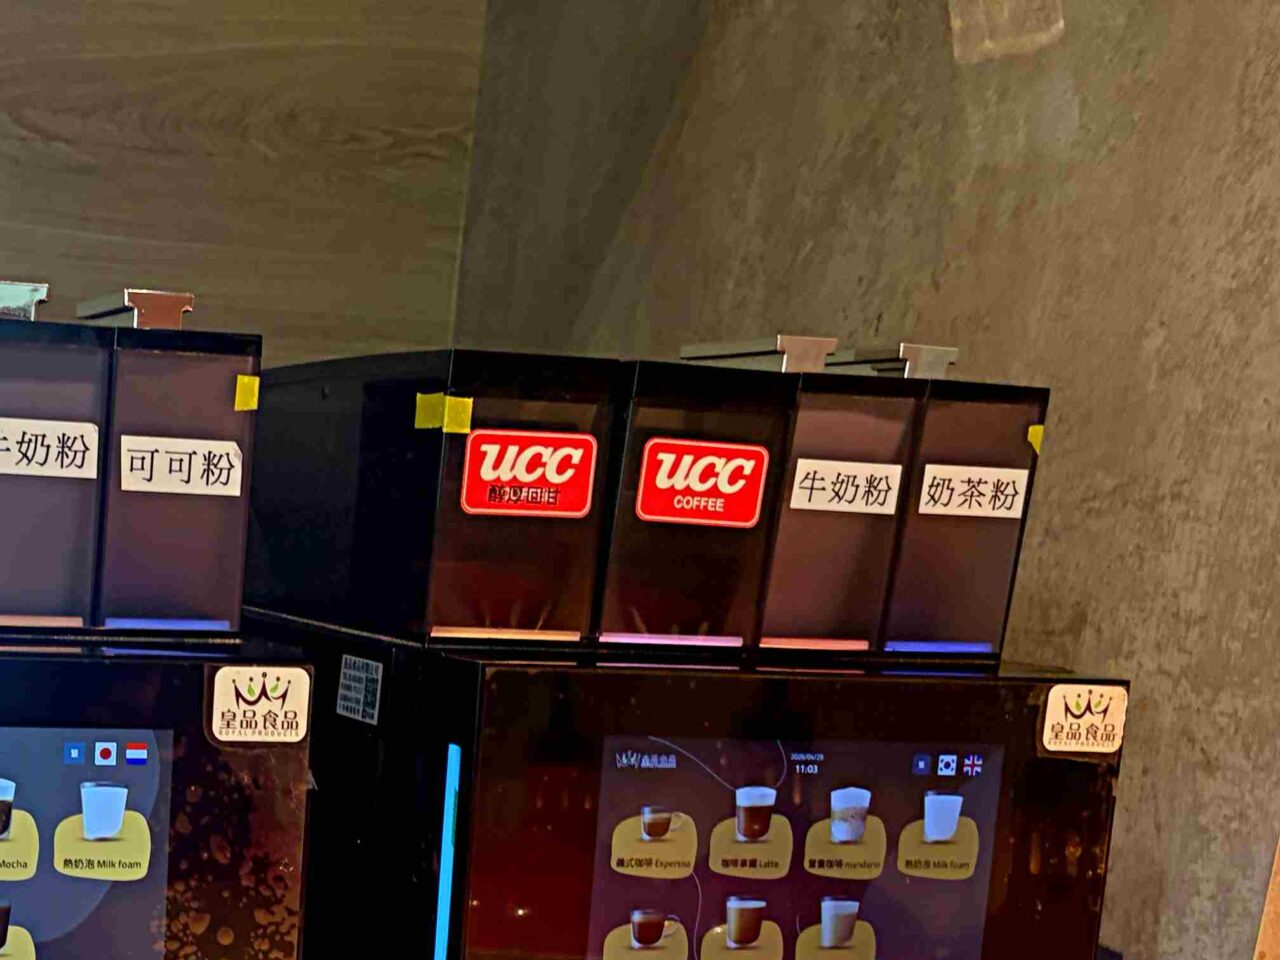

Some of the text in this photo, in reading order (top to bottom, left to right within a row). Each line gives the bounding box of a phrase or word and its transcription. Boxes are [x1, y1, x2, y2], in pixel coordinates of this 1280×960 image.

[126, 447, 235, 487] 可可粉
[479, 443, 584, 484] UCC
[655, 452, 756, 494] UCC
[673, 494, 725, 512] COFFEE
[798, 470, 892, 507] 牛奶粉
[924, 475, 1019, 511] 奶茶粉
[219, 708, 299, 730] 皇品食品
[1048, 721, 1117, 742] 皇品食品
[97, 859, 116, 869] Milk
[118, 859, 142, 869] foam
